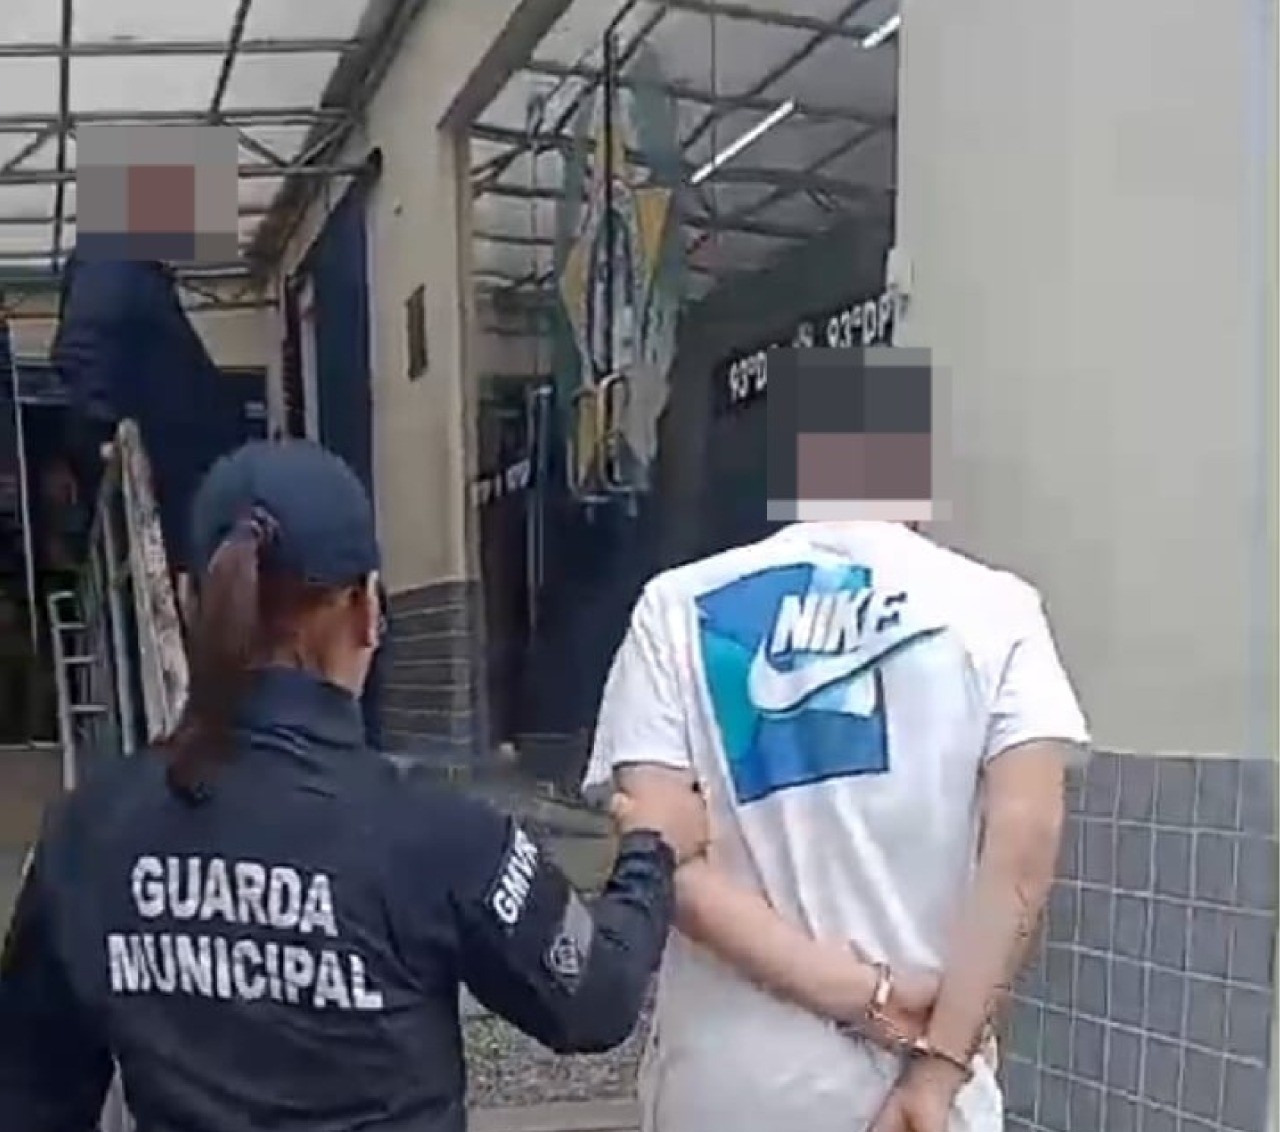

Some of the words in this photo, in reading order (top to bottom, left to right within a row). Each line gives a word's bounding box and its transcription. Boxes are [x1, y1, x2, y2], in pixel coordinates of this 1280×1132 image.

[768, 586, 908, 656] NIKE
[132, 856, 339, 937] GUARDA
[107, 933, 384, 1009] MUNICIPAL
